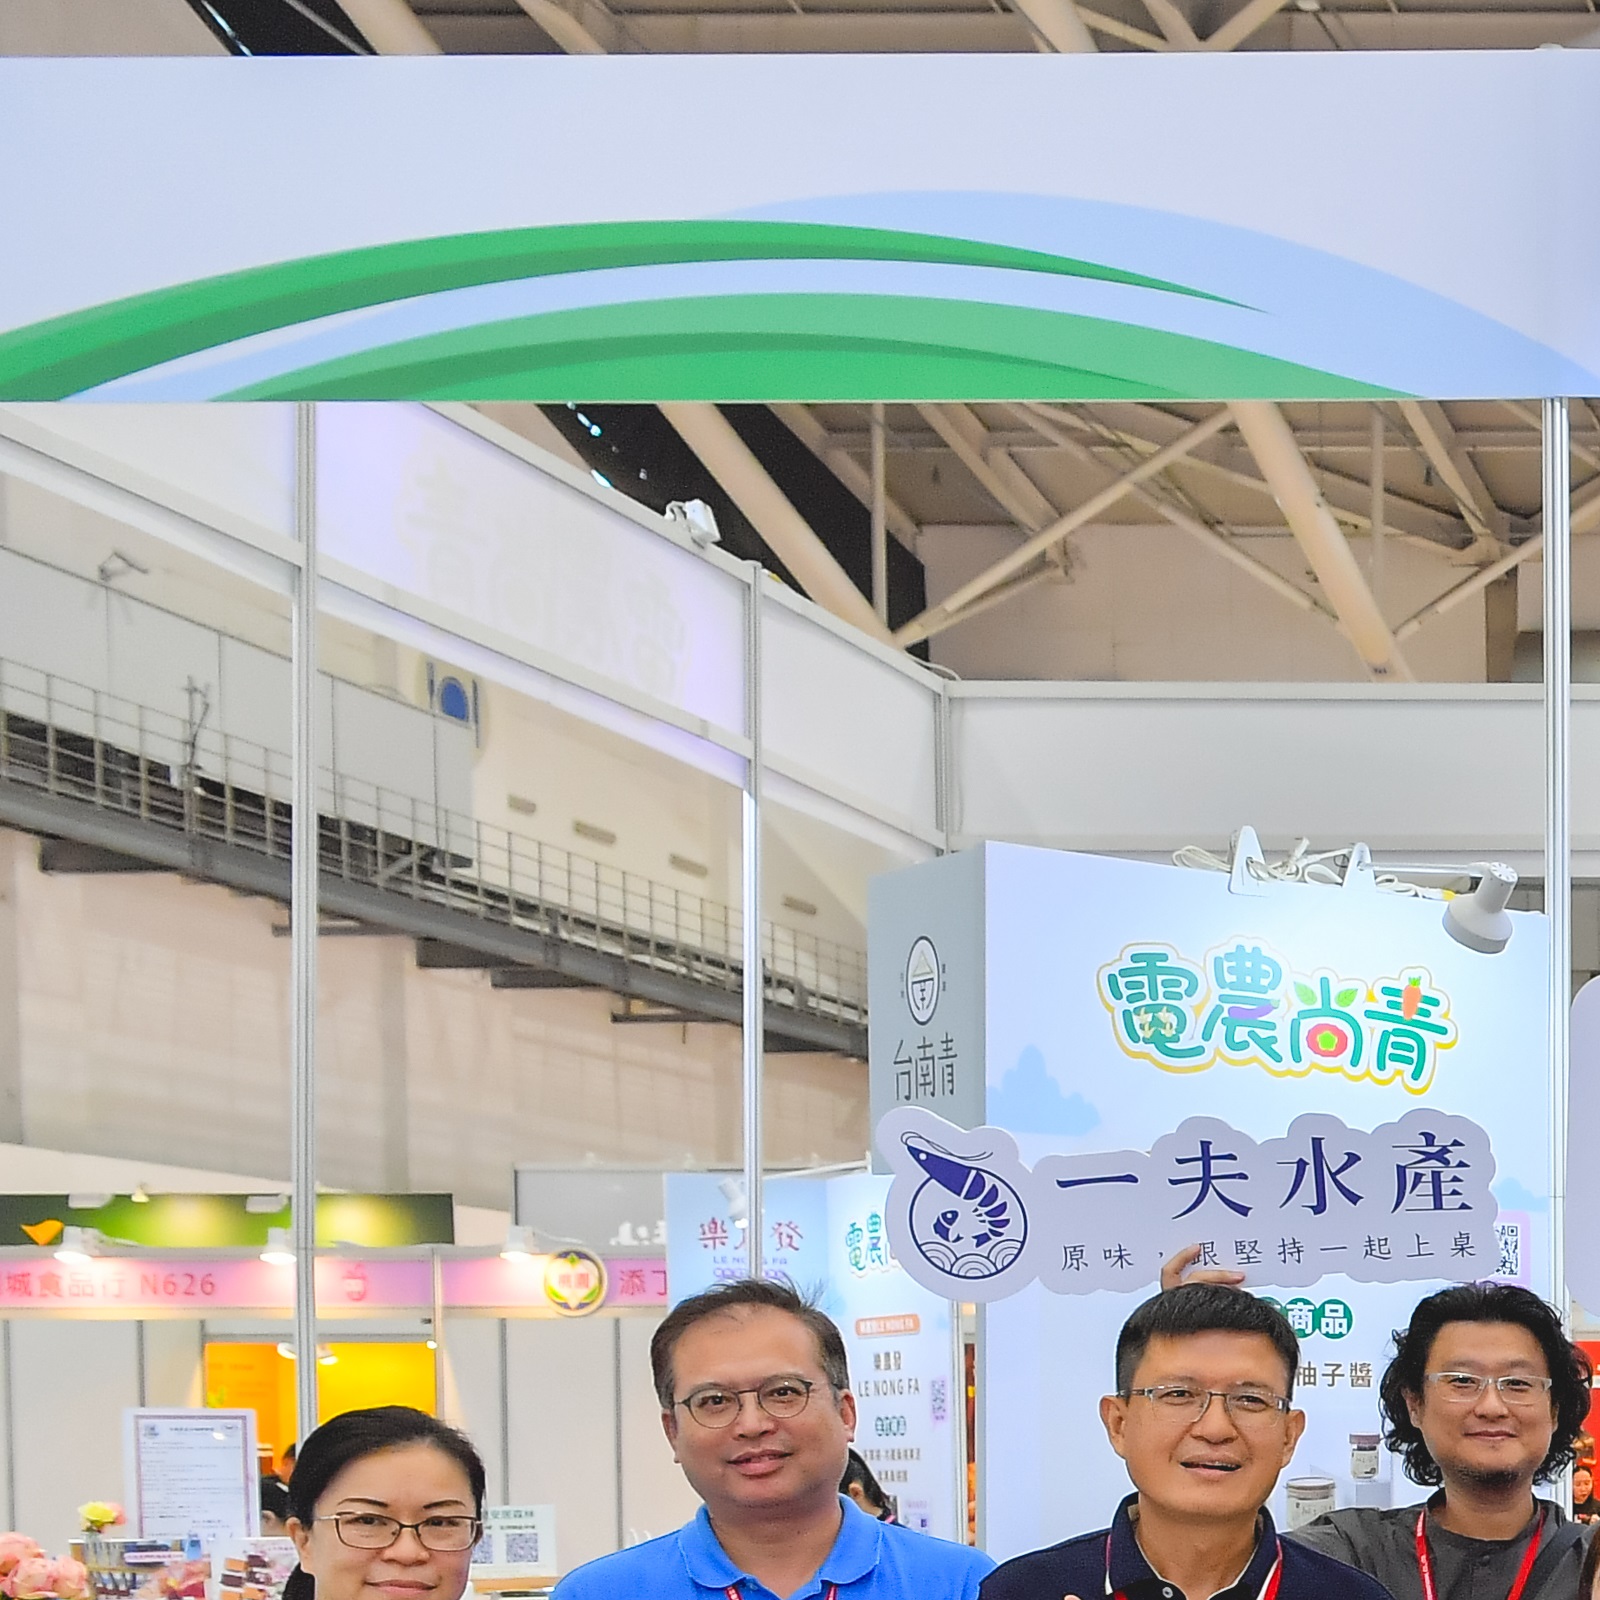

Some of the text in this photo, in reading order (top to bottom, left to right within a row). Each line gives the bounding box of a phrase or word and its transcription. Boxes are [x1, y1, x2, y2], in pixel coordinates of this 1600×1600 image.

[1106, 944, 1450, 1084] 電農尚青
[893, 1031, 958, 1101] 台南青
[1055, 1131, 1475, 1222] 一夫水產
[140, 1273, 217, 1297] N626
[1274, 1302, 1349, 1335] 商品
